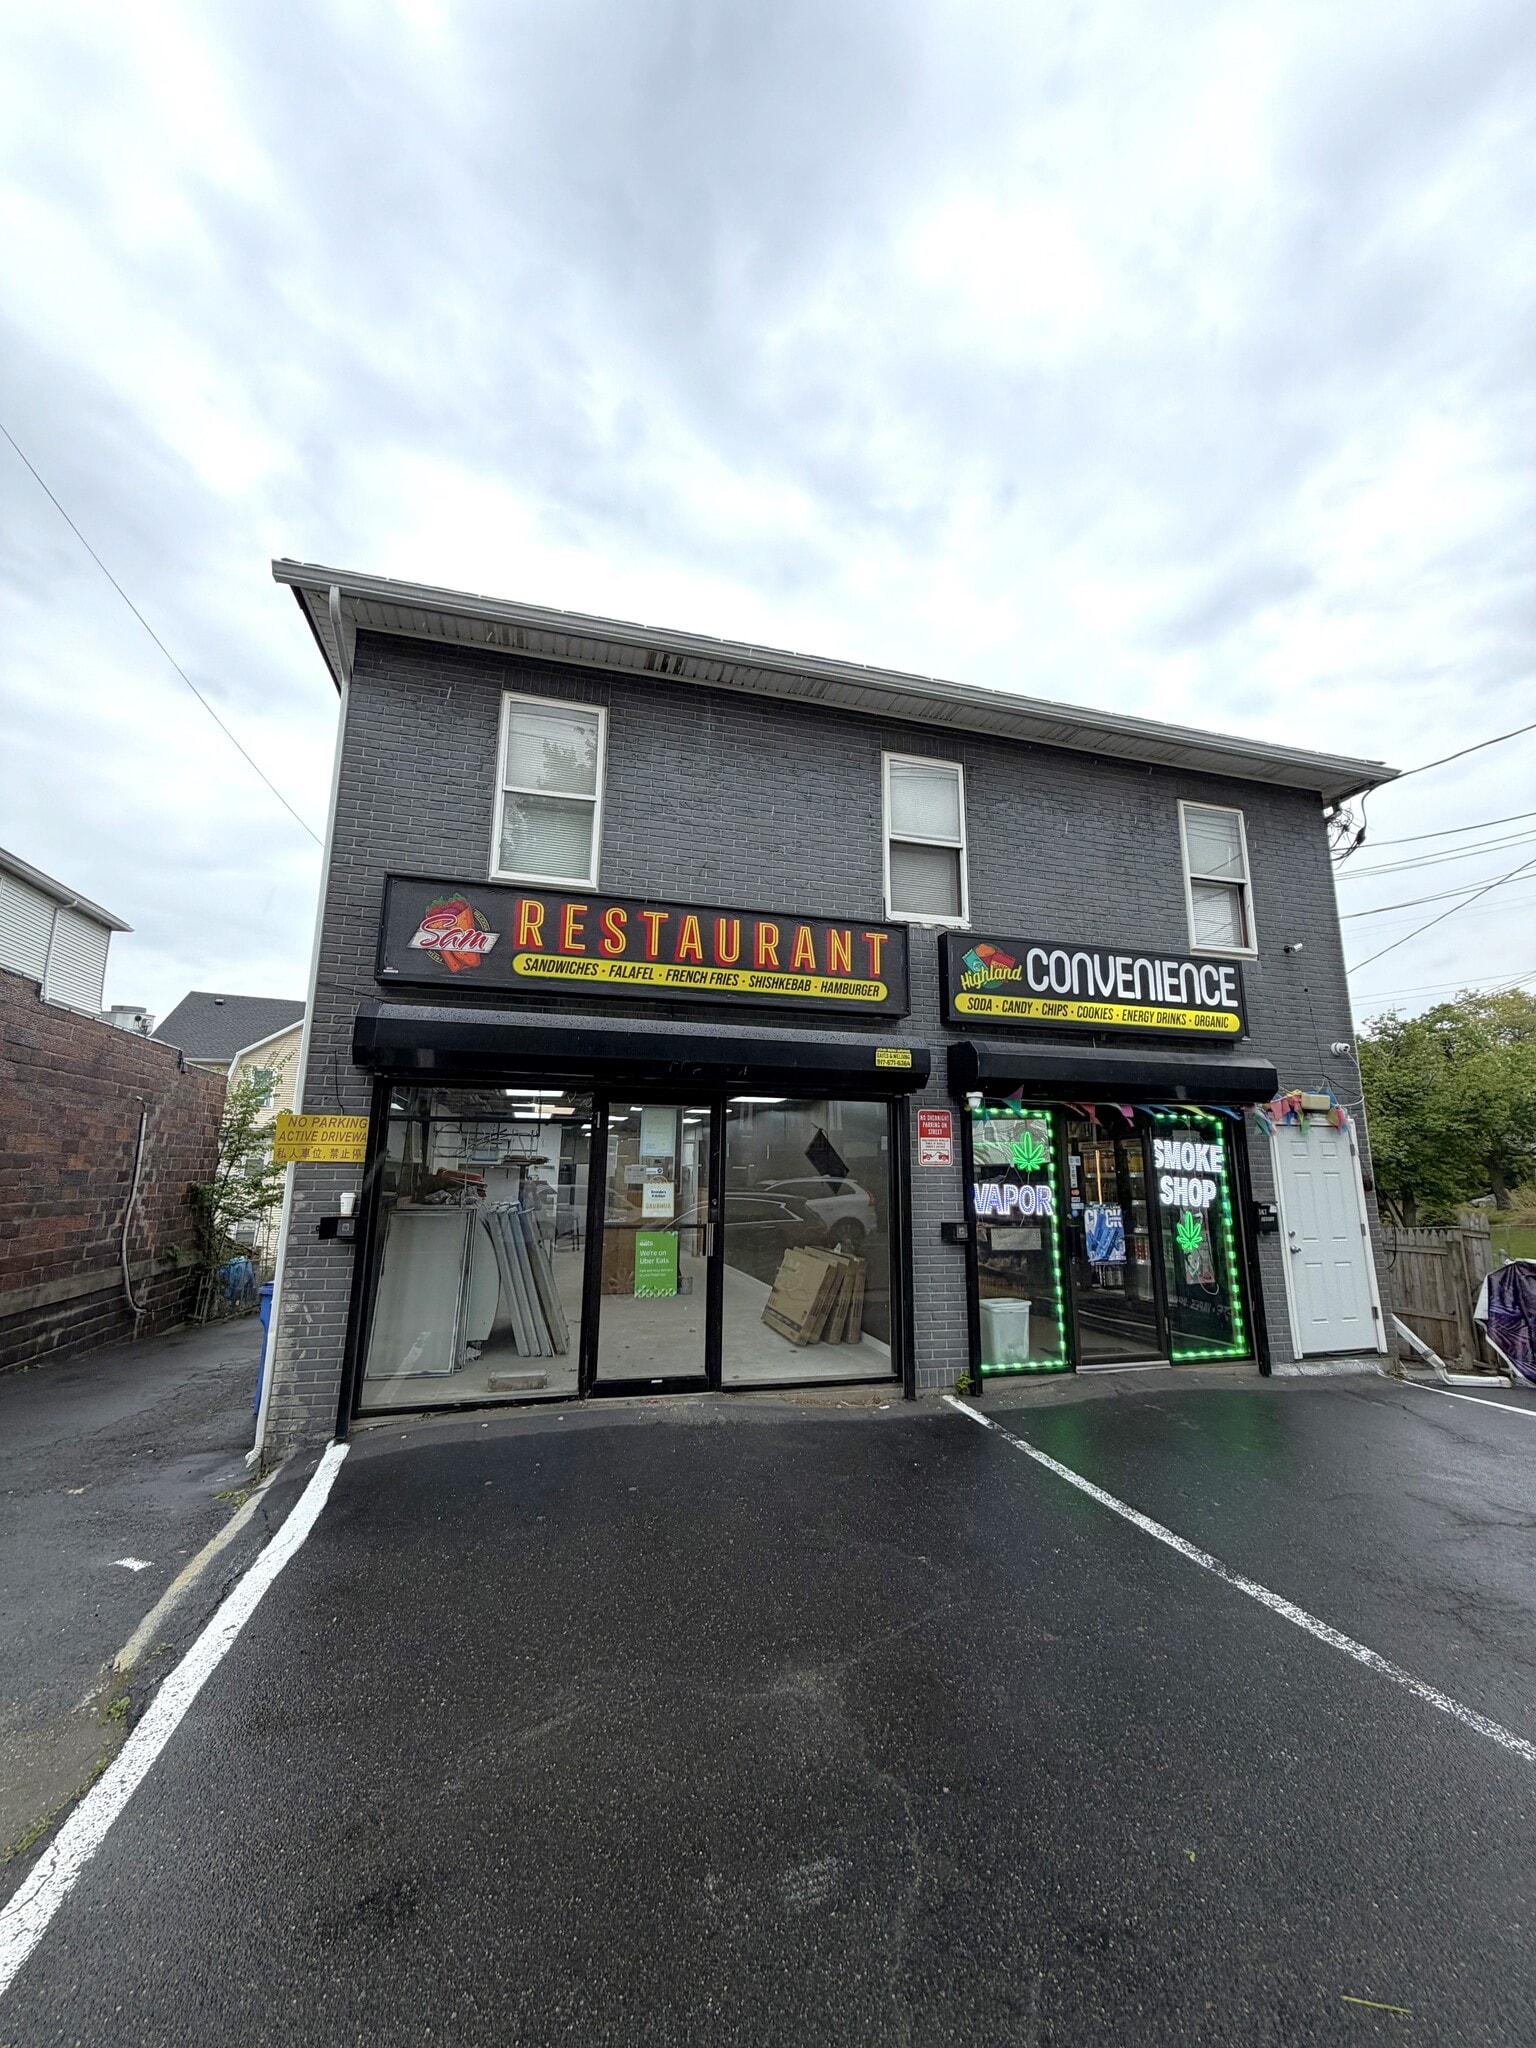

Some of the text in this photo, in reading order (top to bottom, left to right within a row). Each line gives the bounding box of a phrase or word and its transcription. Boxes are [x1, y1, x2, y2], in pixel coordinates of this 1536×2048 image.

[420, 914, 488, 950] Sam
[513, 899, 888, 978] RESTAURANT
[523, 957, 880, 998] SANDWICHES FALAFEL FRENCH FRIES SHISHKEBAB HAMBURGER
[960, 964, 1022, 991] Highland
[1026, 947, 1239, 1008] CONVENIENCE
[967, 997, 1229, 1028] SODA CANDY CHIPS COOKIES ENERGY DRINKS ORGANIC
[279, 1131, 318, 1142] ACTIVE
[288, 1117, 368, 1129] NO PARKING
[922, 1121, 940, 1129] PARKING
[1153, 1139, 1224, 1173] SMOKE
[973, 1183, 1053, 1215] VAPOR
[1160, 1175, 1217, 1208] SHOP
